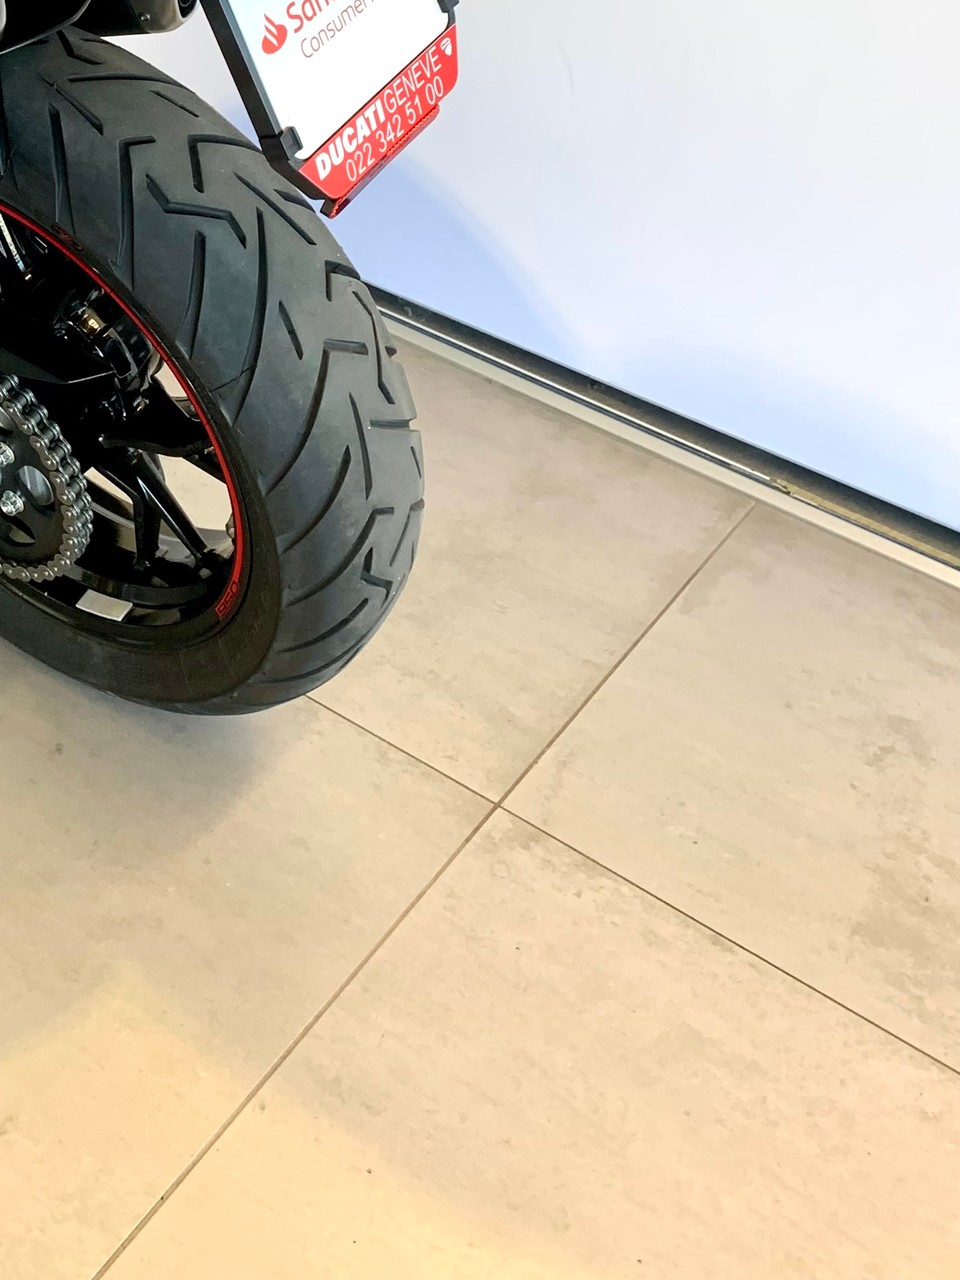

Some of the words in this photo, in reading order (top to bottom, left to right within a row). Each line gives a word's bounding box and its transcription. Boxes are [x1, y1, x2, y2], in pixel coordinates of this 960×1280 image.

[314, 98, 386, 181] DUCATI
[383, 45, 442, 114] GENEVE
[345, 142, 376, 182] 022
[375, 113, 405, 153] 342
[404, 94, 423, 125] 51
[424, 75, 444, 105] 00
